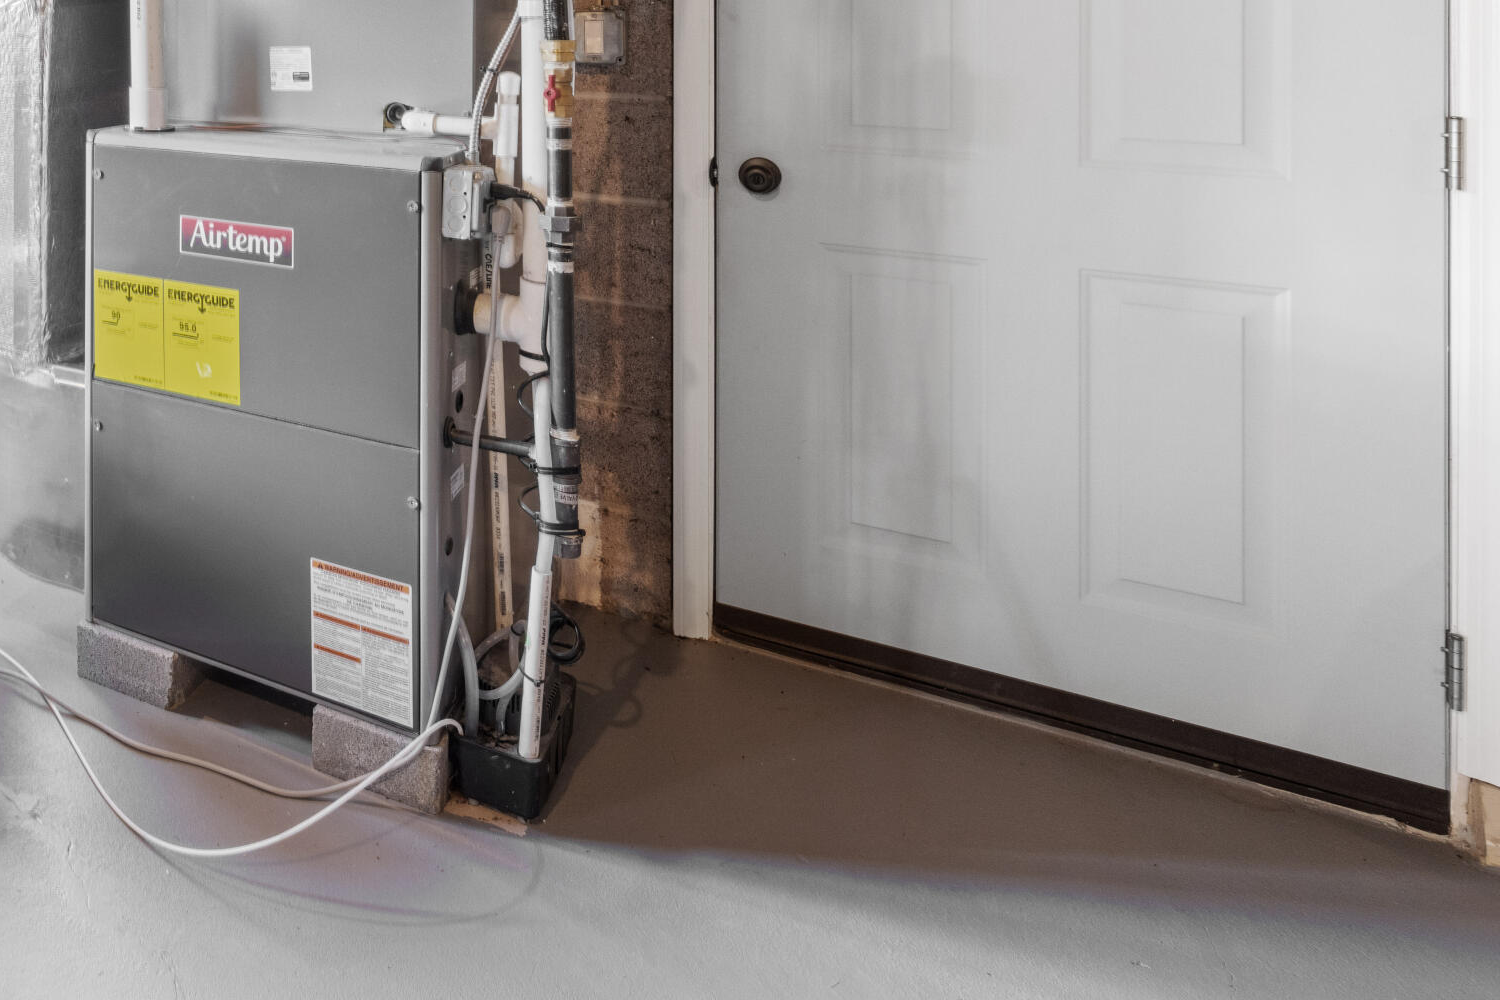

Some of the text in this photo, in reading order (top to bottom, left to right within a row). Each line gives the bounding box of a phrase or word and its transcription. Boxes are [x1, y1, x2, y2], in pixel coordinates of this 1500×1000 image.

[189, 219, 284, 263] Airtemp
[97, 277, 160, 299] ENERGYGUIDE
[167, 288, 236, 310] ENERGYGUIDE
